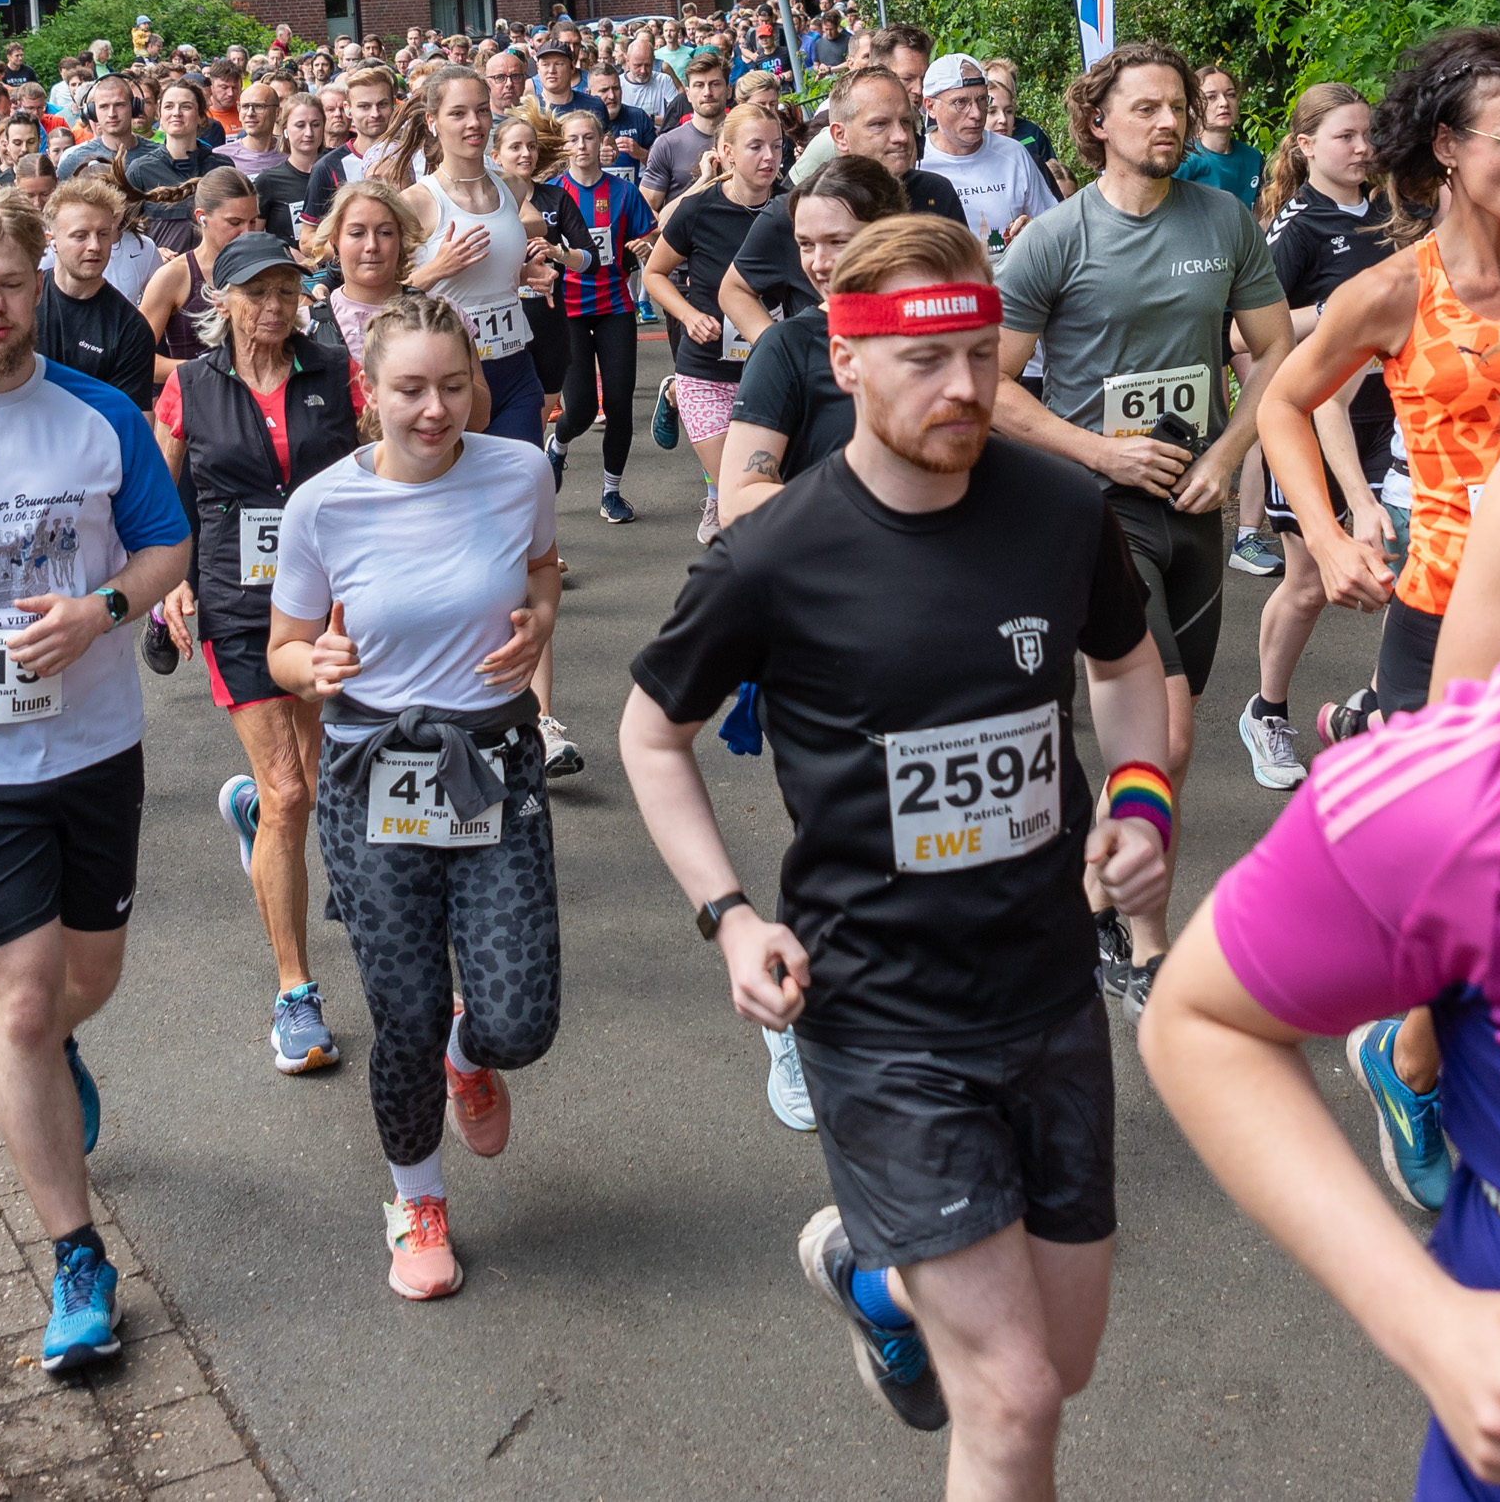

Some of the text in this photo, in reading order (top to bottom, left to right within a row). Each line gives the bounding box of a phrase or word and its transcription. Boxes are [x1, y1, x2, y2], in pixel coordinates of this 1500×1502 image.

[903, 295, 978, 317] #BALLERN
[502, 339, 521, 350] bruns
[1112, 371, 1204, 390] Everstener Brunnenlauf
[1122, 383, 1195, 419] 610
[15, 489, 86, 509] Brunnenlauf
[251, 564, 277, 578] EW
[7, 613, 45, 626] VIERO
[12, 695, 51, 712] bruns
[900, 717, 1051, 756] Everstener Brunnenlauf
[381, 757, 434, 767] Everstener
[895, 732, 1056, 816] 2594
[389, 770, 446, 807] 41
[424, 809, 448, 819] Finja
[518, 806, 543, 817] adidas
[964, 804, 1013, 822] Patrick
[381, 817, 430, 836] EWE
[450, 820, 490, 834] bruns
[1009, 809, 1050, 840] bruns
[915, 827, 982, 860] EWE
